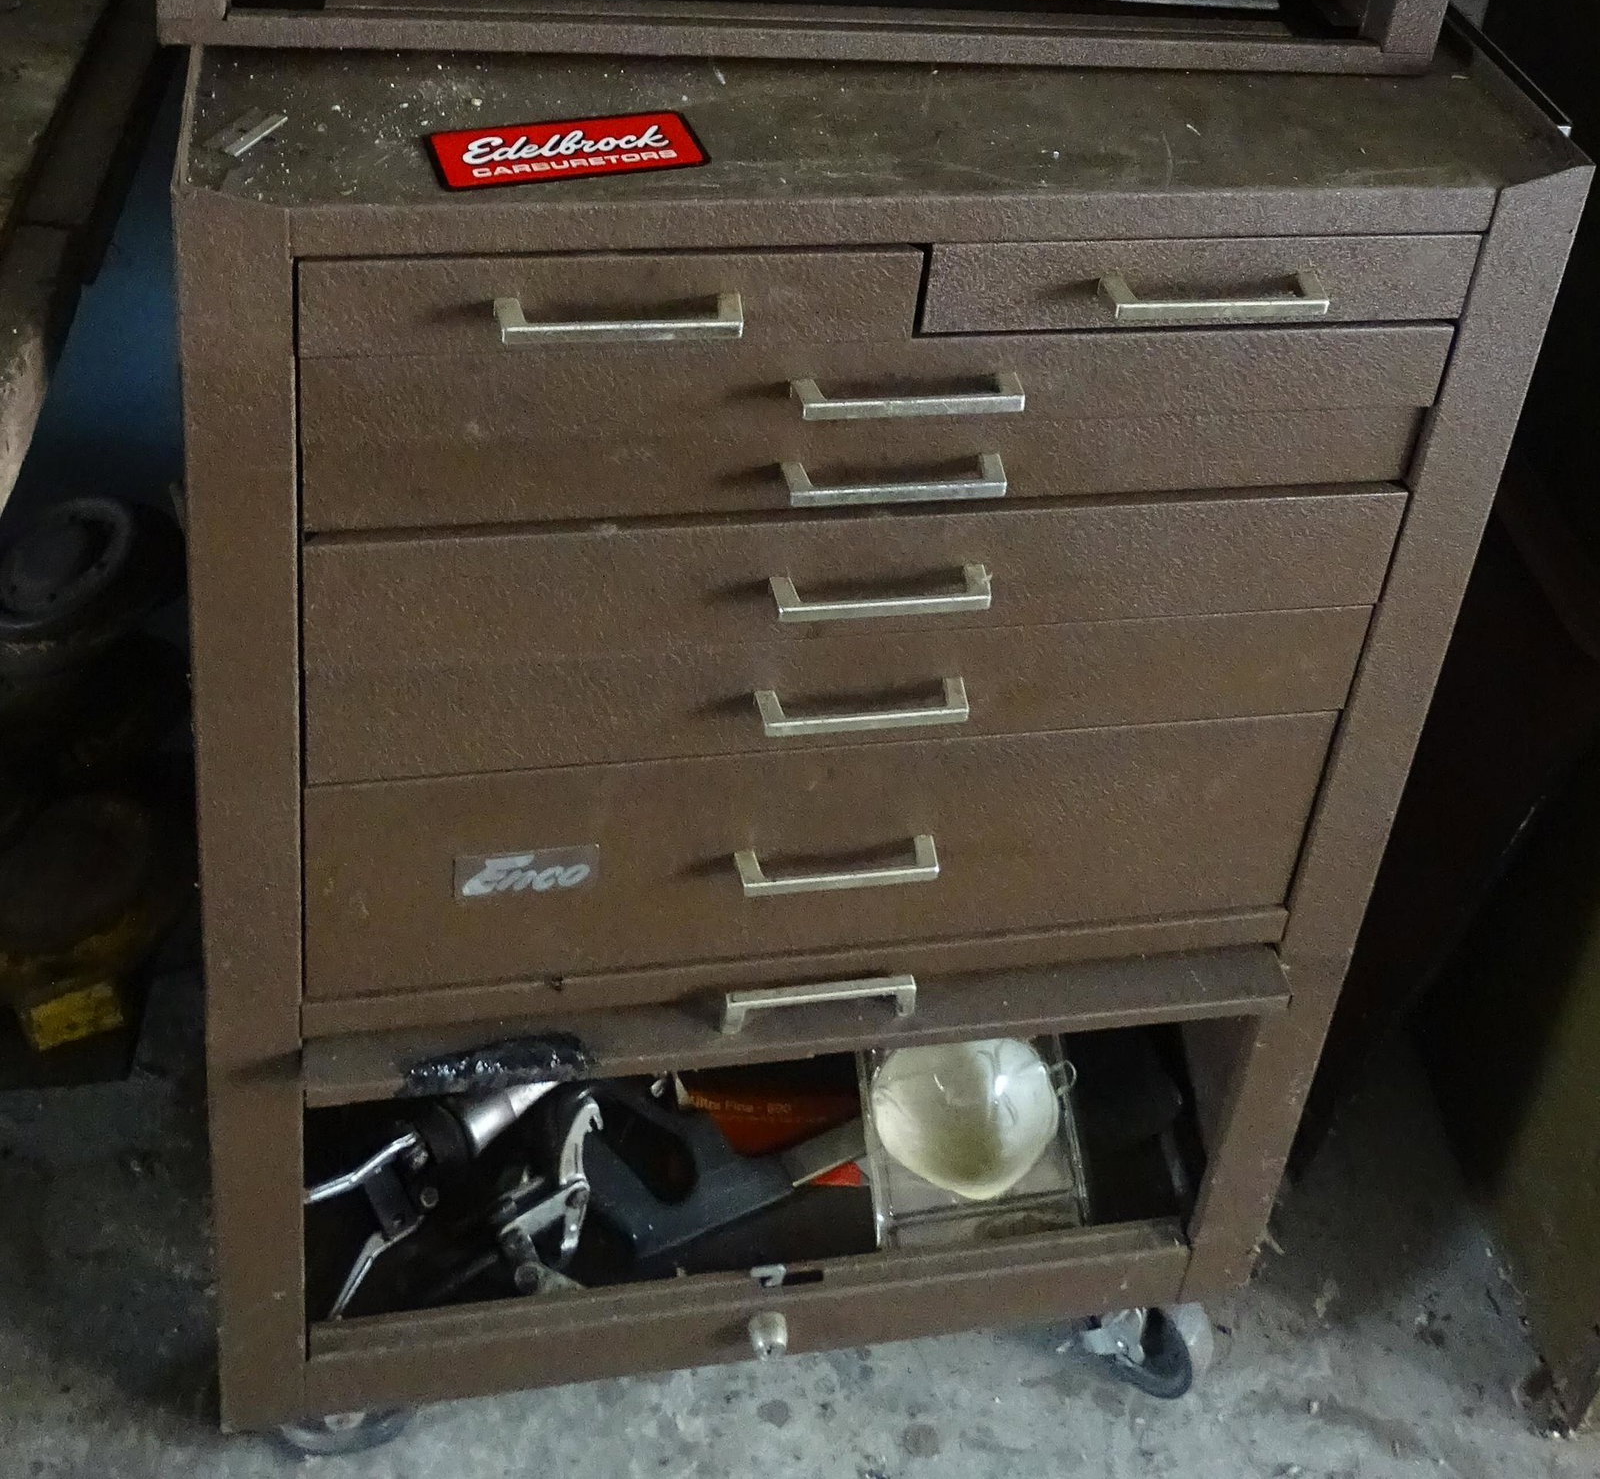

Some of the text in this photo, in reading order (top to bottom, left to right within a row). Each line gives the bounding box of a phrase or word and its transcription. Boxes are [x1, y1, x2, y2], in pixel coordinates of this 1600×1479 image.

[462, 125, 669, 165] Edelbrock
[472, 150, 678, 178] CARBURETORS
[462, 854, 591, 897] Enco
